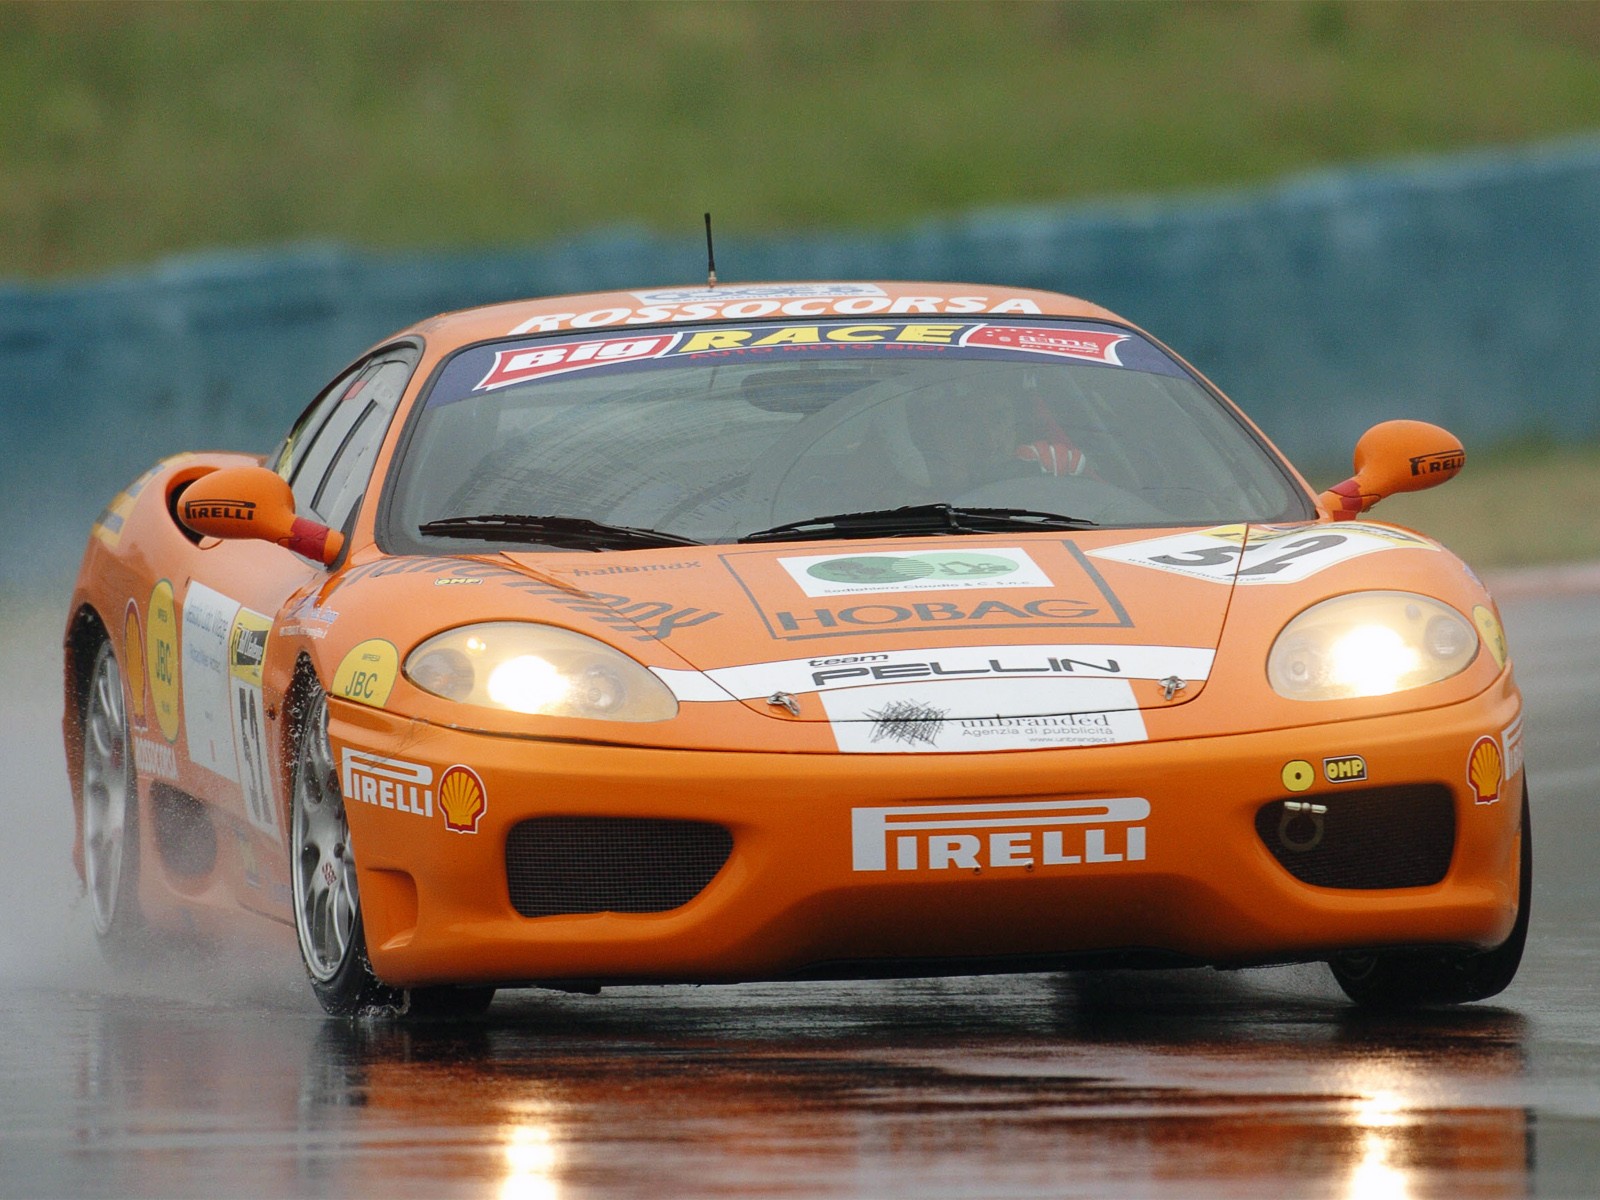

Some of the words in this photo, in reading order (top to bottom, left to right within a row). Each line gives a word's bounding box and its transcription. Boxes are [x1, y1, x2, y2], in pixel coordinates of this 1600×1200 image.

[506, 296, 1042, 336] ROSSOCORSA
[678, 325, 965, 353] RACE
[184, 498, 257, 521] PIRELLI
[1147, 534, 1348, 577] 52
[776, 599, 1100, 631] HOBAG
[155, 638, 173, 687] JBC
[808, 653, 889, 668] team
[811, 656, 1121, 686] PELLIN
[344, 670, 378, 699] JBC
[960, 713, 1111, 728] unbranded
[962, 728, 1020, 738] Agenzia
[1024, 727, 1038, 735] di
[1043, 726, 1114, 736] pubblicità
[341, 746, 434, 818] PIRELLI
[1326, 759, 1364, 779] OMP
[851, 797, 1151, 872] PIRELLI
